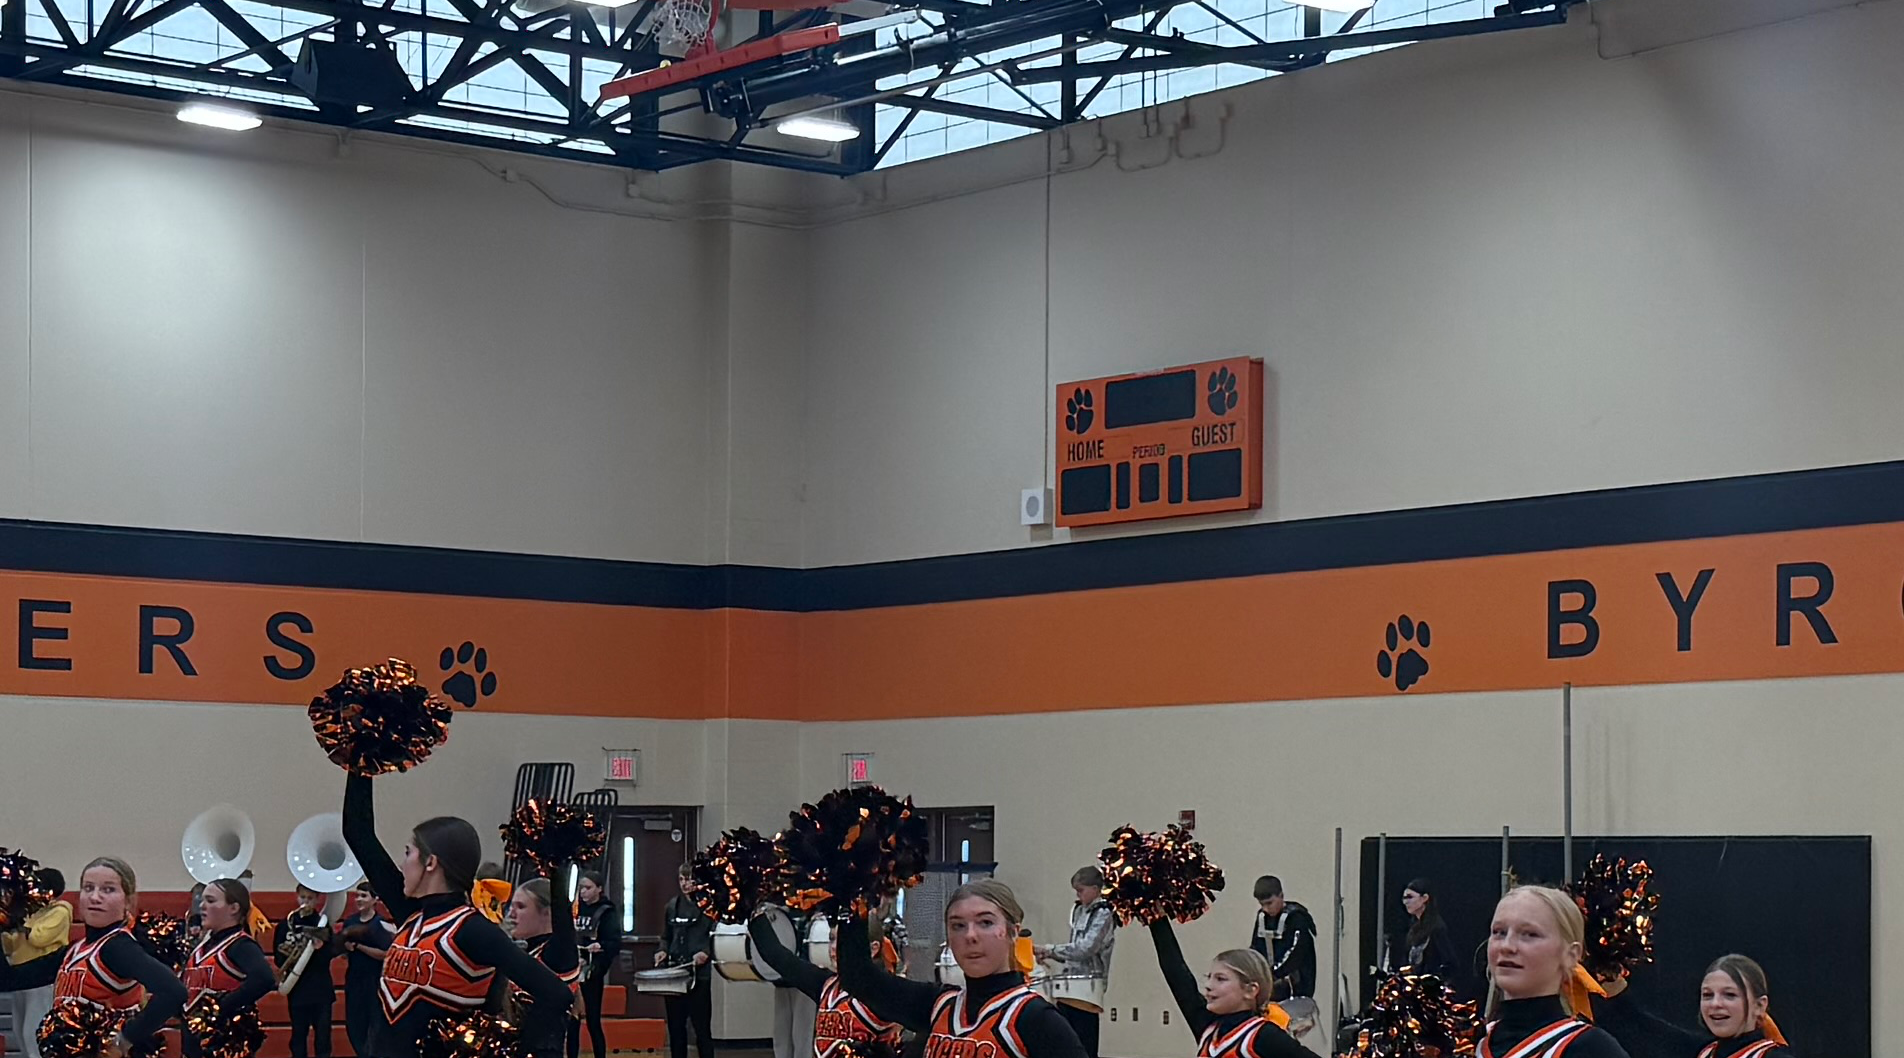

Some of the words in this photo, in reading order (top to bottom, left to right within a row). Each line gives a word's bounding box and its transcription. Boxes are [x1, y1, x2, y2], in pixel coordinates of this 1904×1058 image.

[1192, 422, 1237, 447] GUEST
[1067, 439, 1105, 462] HOME
[1132, 443, 1166, 459] PERIOD
